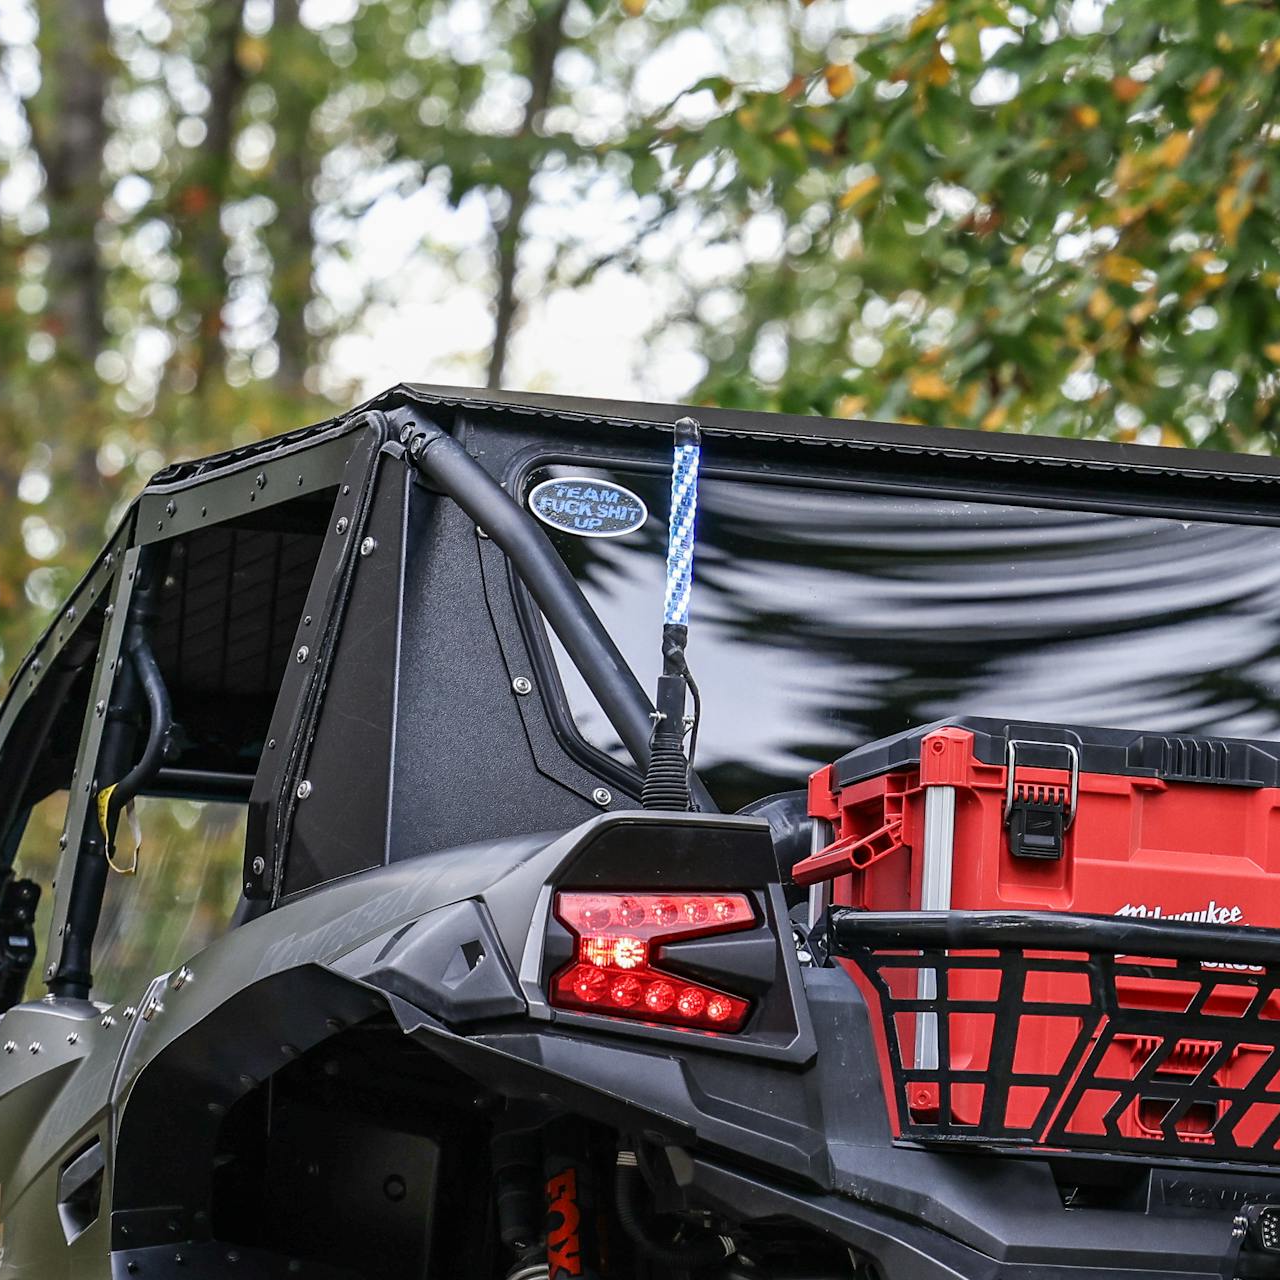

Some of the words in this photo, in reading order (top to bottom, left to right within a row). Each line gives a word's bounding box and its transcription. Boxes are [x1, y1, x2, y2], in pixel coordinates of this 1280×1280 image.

[554, 484, 620, 504] TEAM
[538, 497, 593, 517] FUCK
[597, 504, 641, 522] SHIT
[574, 517, 603, 530] UP
[546, 1167, 582, 1280] FOX
